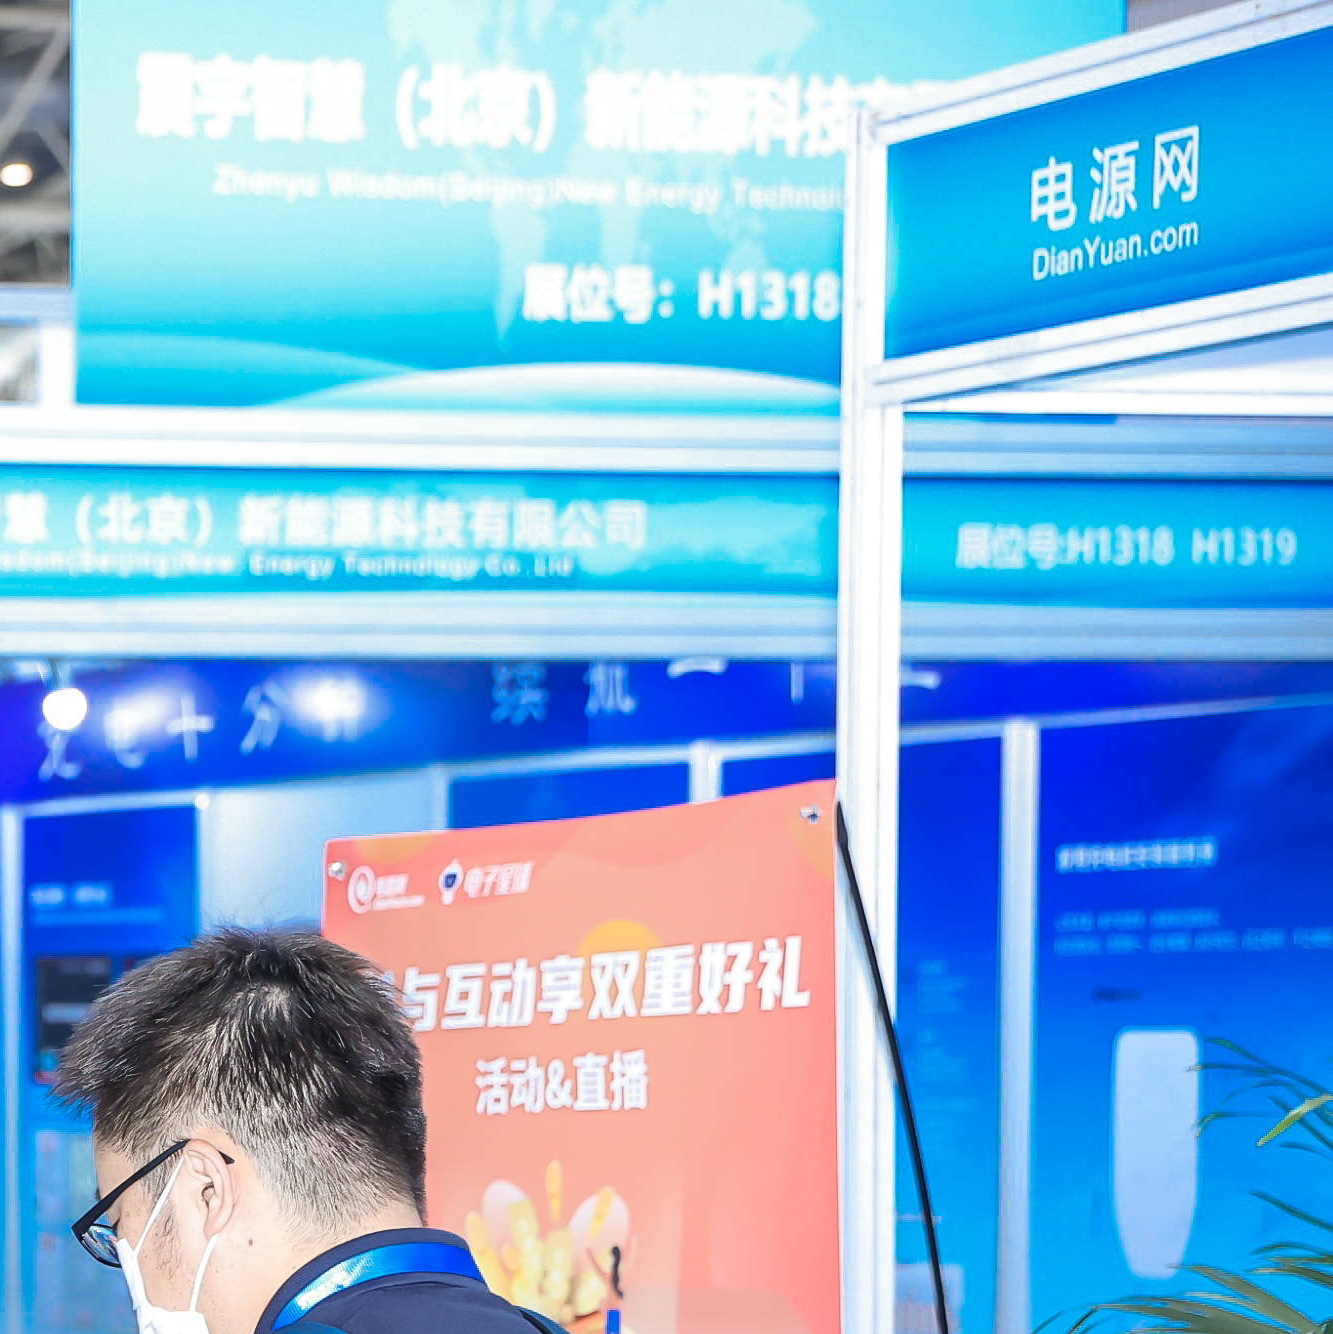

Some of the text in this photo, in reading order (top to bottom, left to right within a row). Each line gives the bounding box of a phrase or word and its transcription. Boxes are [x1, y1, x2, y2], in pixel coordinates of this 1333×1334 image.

[625, 175, 721, 214] Energy
[1031, 124, 1200, 231] 电源网
[1033, 221, 1199, 281] DianYuan.com
[697, 269, 842, 322] H1318
[1191, 525, 1298, 567] H1319
[385, 934, 811, 1033] 与互动享双重好礼
[475, 1048, 649, 1115] 活动&直播
